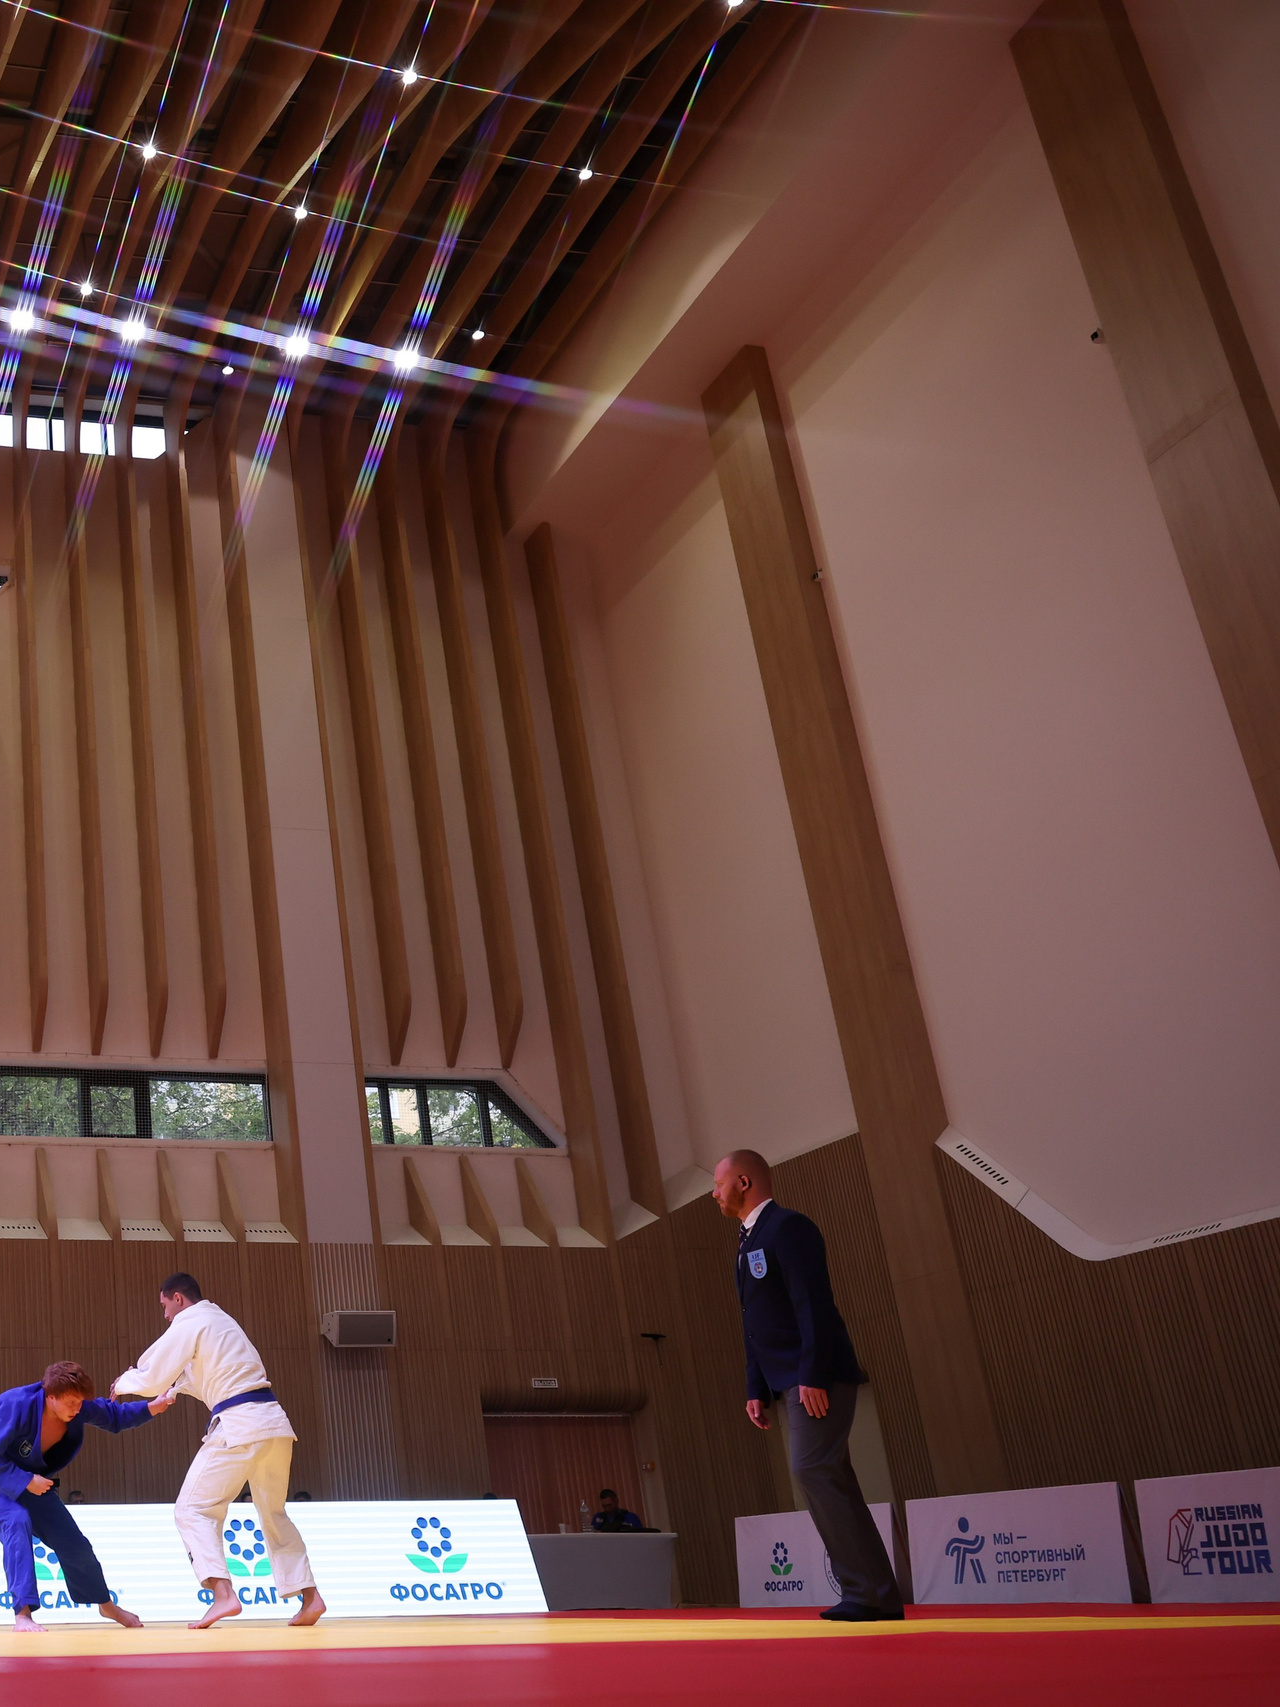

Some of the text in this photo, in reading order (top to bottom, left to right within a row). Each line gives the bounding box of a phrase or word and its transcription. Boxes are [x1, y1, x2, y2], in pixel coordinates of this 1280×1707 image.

[1194, 1503, 1263, 1522] RUSSIAN
[993, 1532, 1013, 1545] МЫ
[1200, 1522, 1268, 1548] JUDO
[995, 1544, 1086, 1564] СПОРТИВНЫЙ
[1202, 1549, 1274, 1575] TOUR
[997, 1568, 1066, 1583] ПЕТЕРБУРГ
[390, 1582, 503, 1601] ФОСАГРО
[764, 1580, 803, 1592] ФОСАГРО
